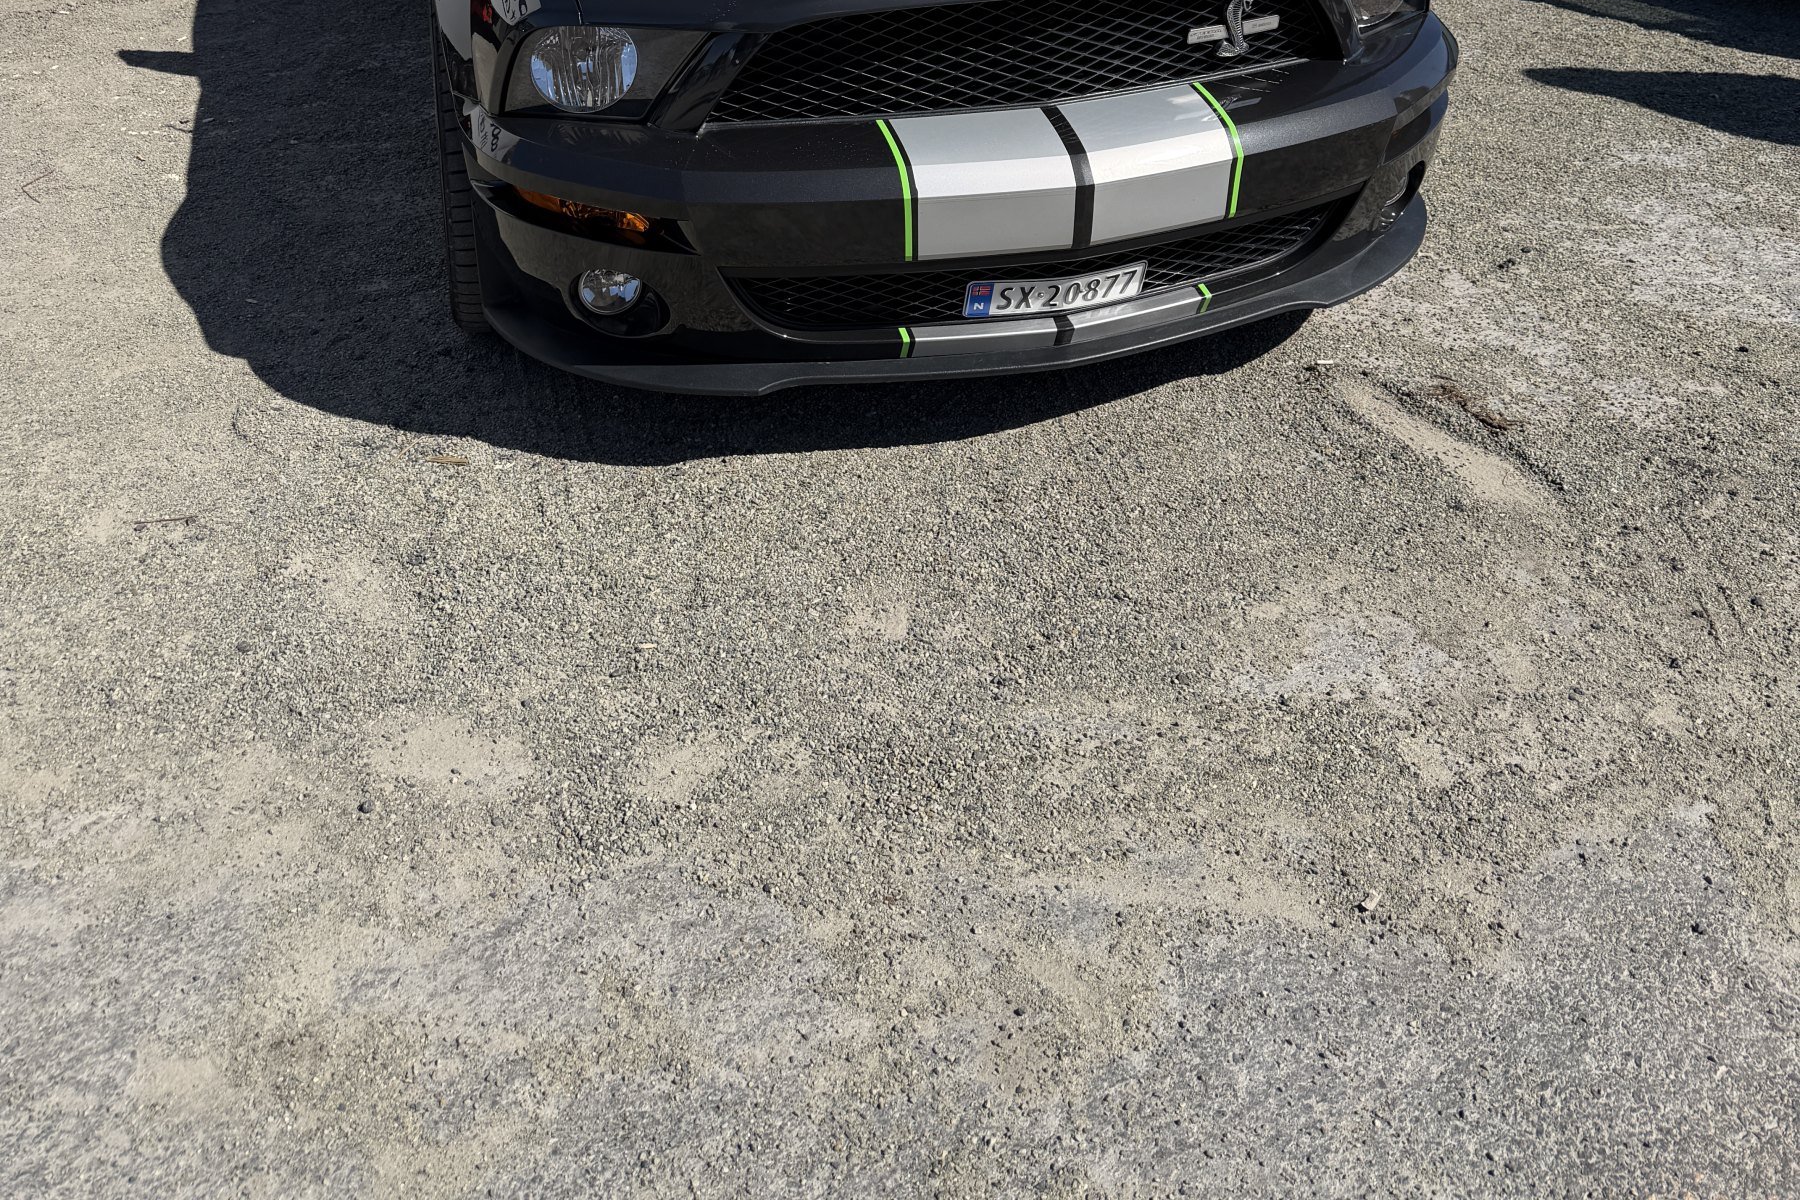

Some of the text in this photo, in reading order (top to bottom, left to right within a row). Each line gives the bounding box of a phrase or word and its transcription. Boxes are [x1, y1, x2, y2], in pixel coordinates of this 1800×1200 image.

[996, 269, 1139, 311] SX 20877
[973, 302, 985, 311] N
